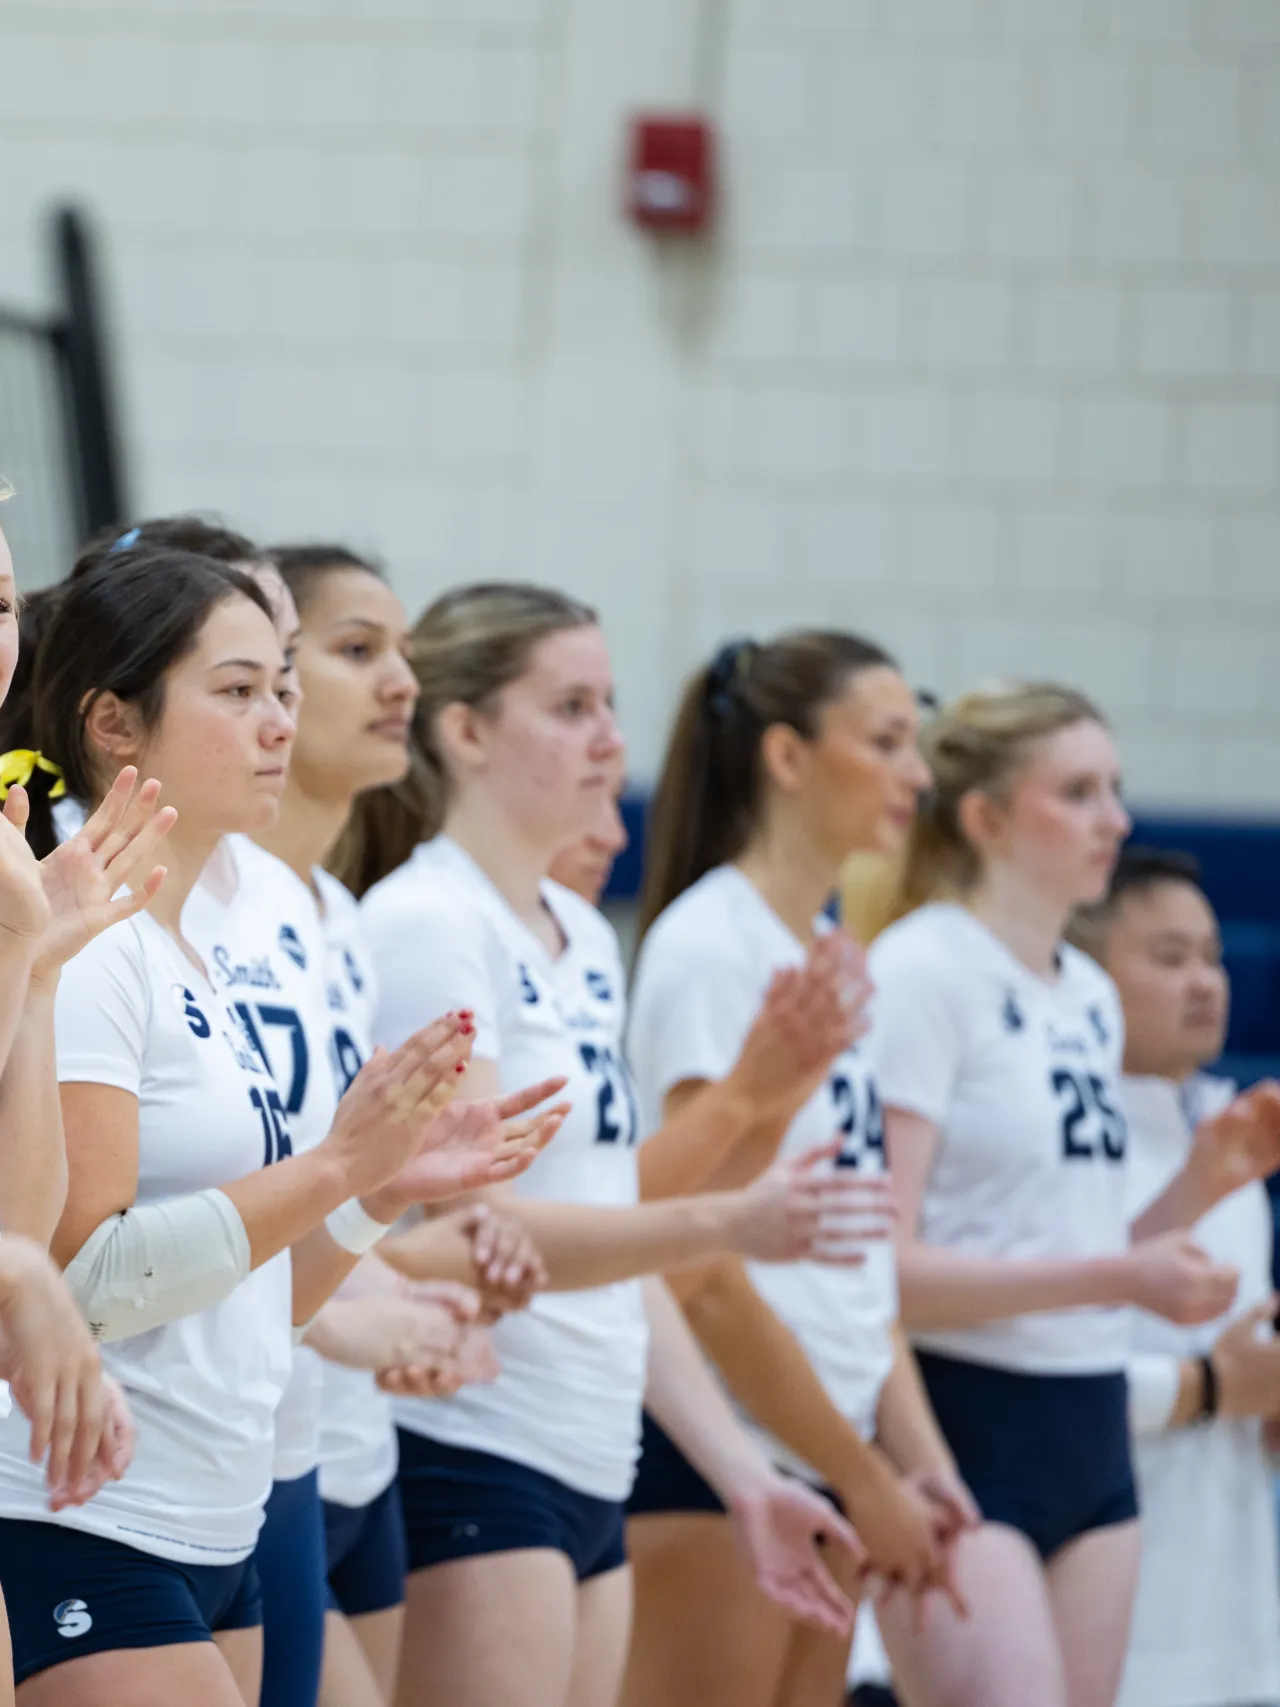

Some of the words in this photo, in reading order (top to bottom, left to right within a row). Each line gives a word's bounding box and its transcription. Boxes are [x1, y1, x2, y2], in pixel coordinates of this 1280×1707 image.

[213, 944, 282, 992] Smith
[233, 1001, 311, 1115] 17
[1049, 1070, 1127, 1161] 25
[53, 1599, 93, 1638] S
